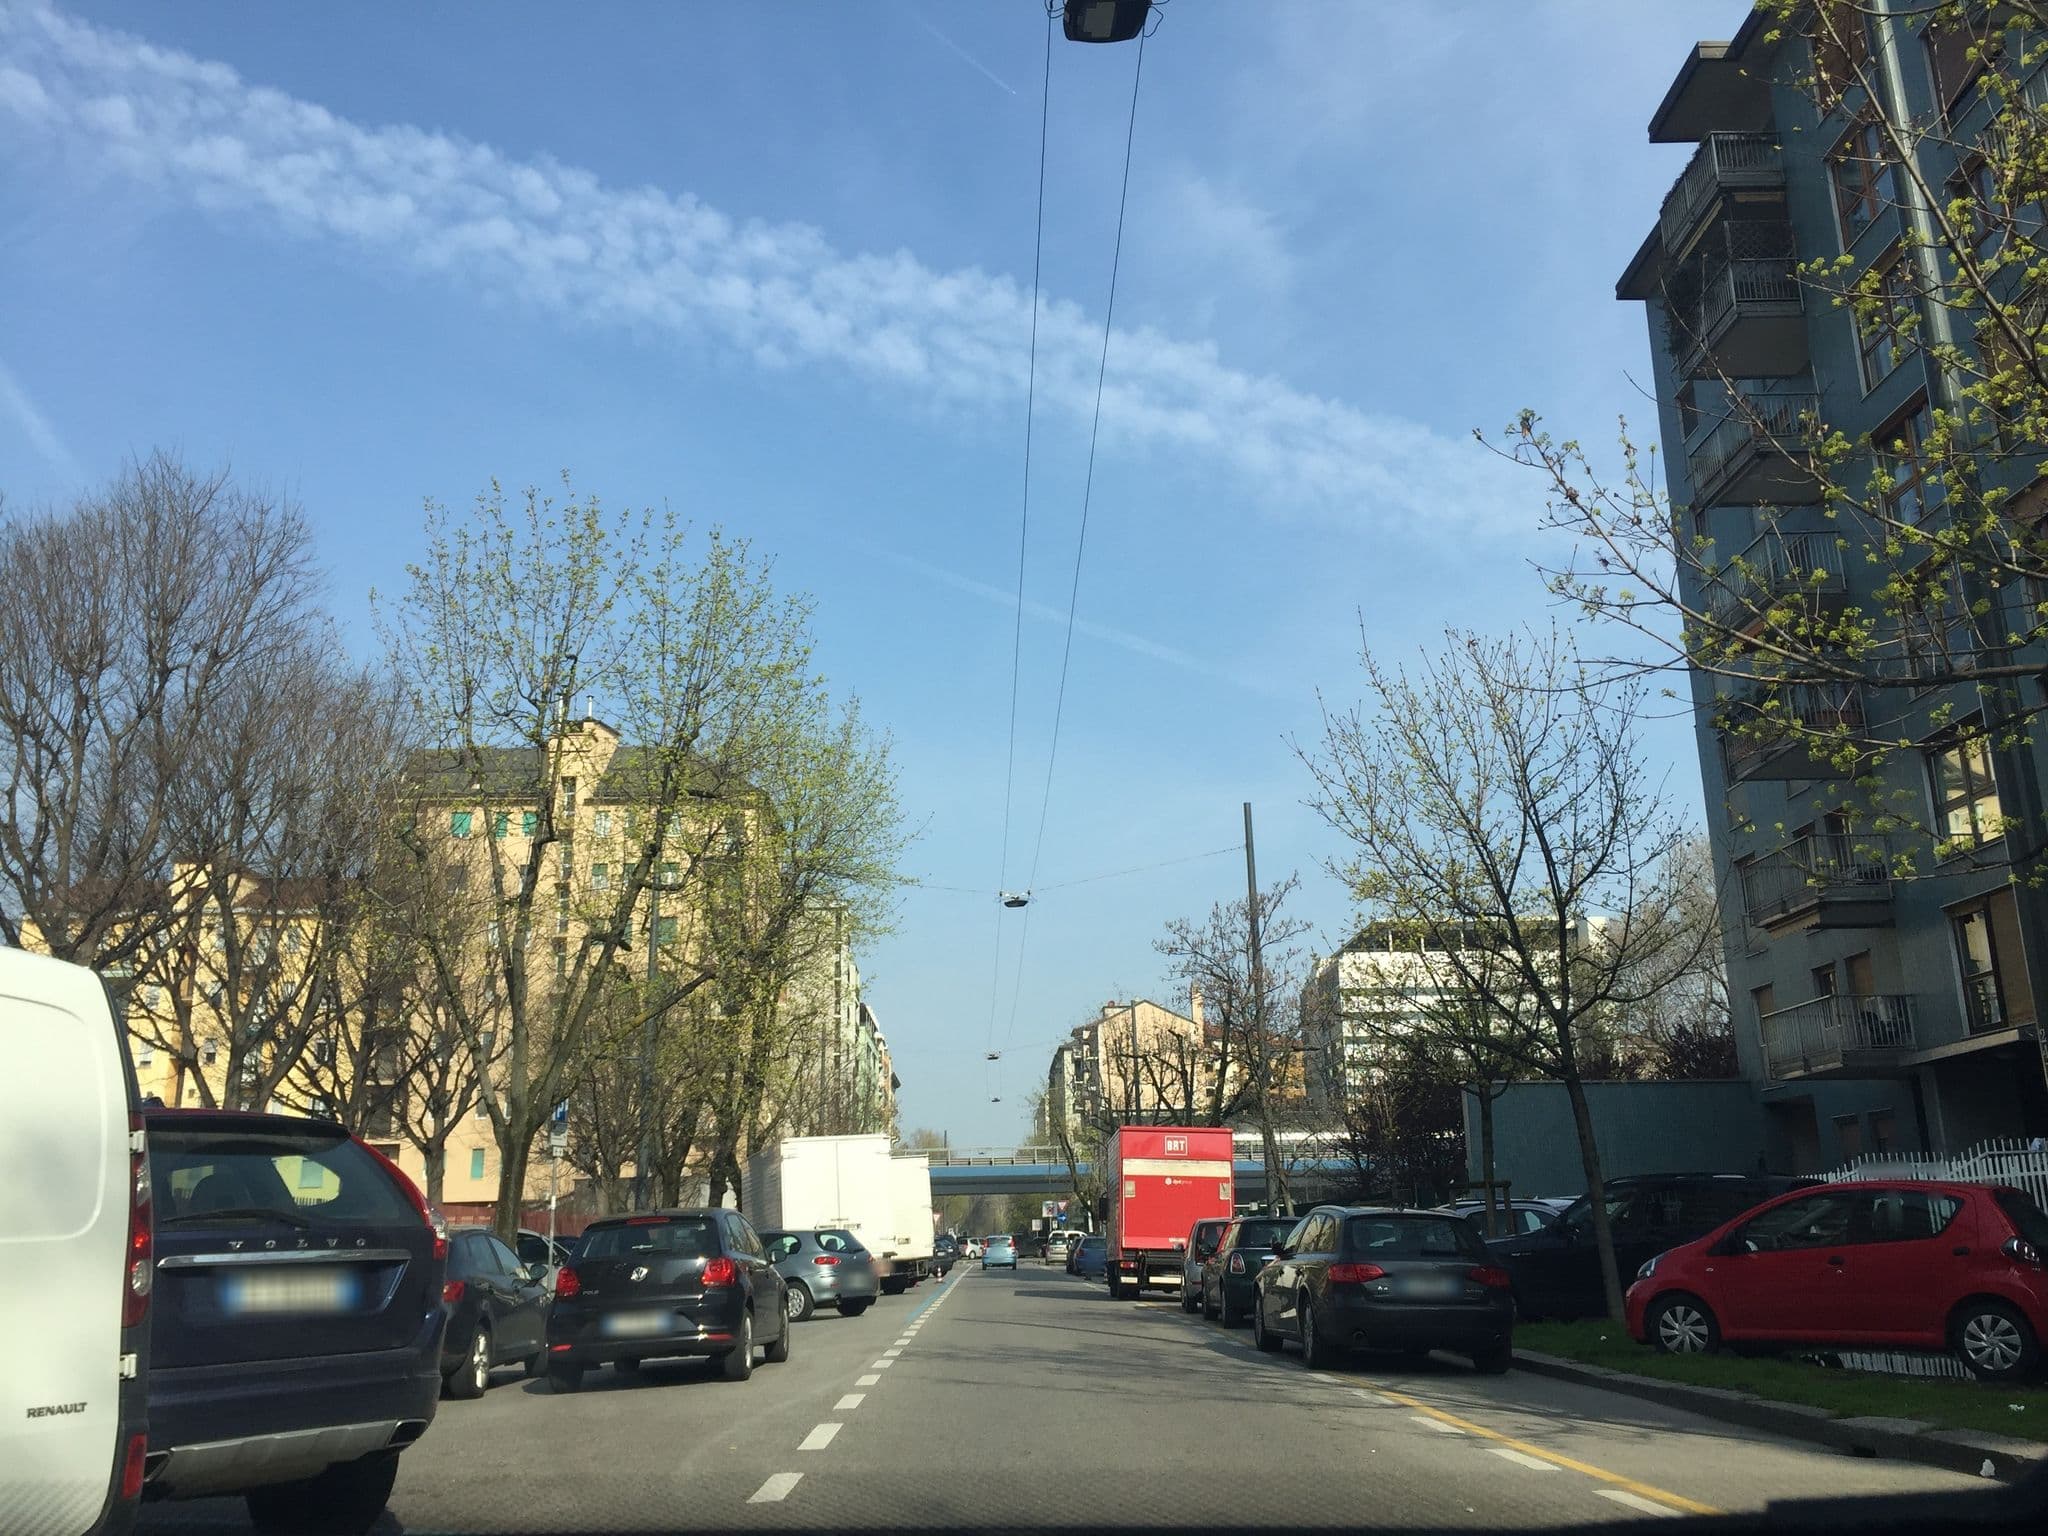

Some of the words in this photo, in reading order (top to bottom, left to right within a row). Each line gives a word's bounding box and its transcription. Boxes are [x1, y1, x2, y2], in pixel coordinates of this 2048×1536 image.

[1167, 1140, 1185, 1151] BRT
[229, 1237, 366, 1250] VOLVO
[26, 1401, 88, 1419] RENAULT
